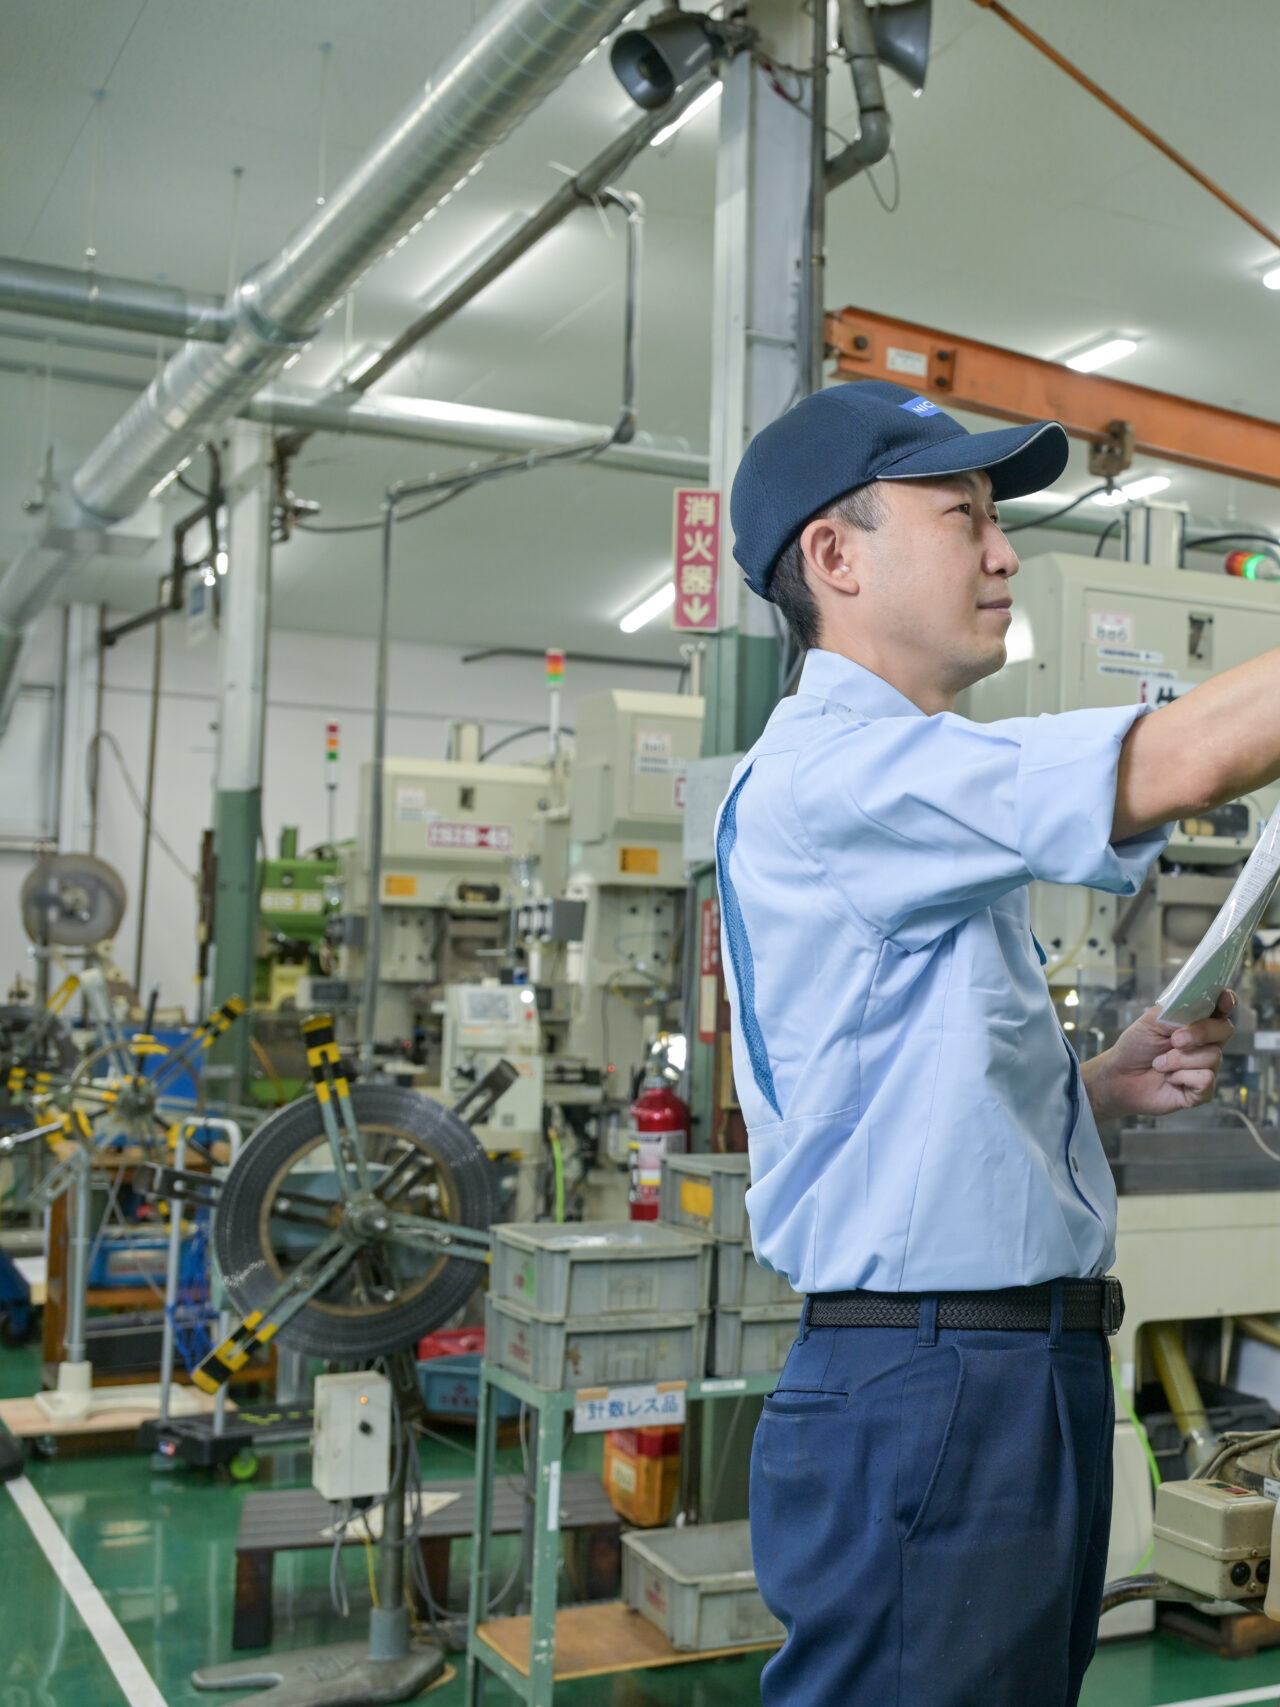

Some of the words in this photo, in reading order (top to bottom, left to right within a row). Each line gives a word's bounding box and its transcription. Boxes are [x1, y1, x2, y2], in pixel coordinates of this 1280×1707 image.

[682, 495, 715, 596] 消火器
[588, 1394, 679, 1421] 計数レス品
